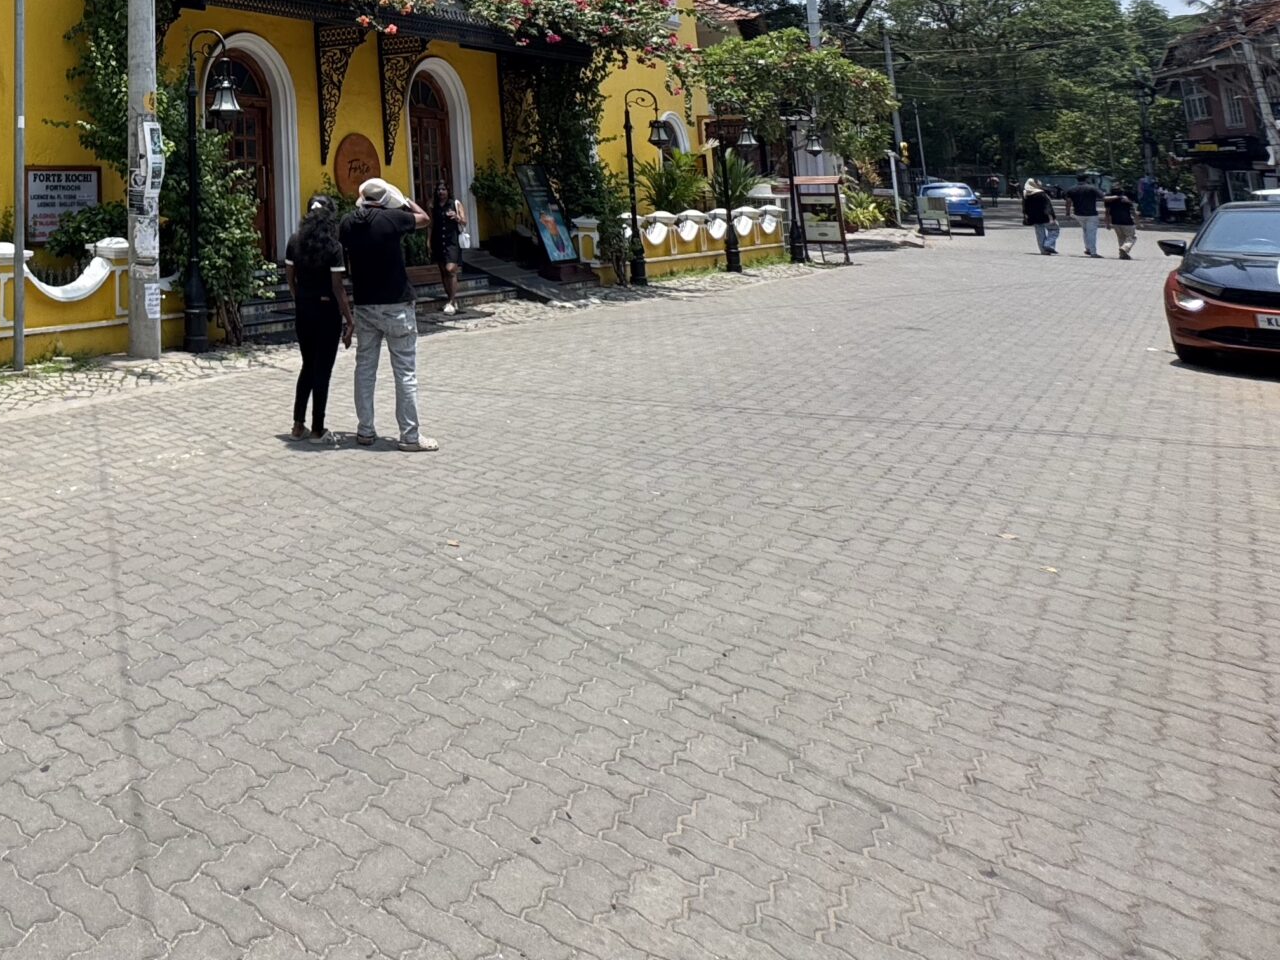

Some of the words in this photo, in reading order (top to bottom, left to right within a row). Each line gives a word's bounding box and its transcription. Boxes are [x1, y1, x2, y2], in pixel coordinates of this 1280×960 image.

[347, 158, 371, 177] Forte
[33, 173, 63, 183] FORTE
[65, 173, 92, 183] KOCHI
